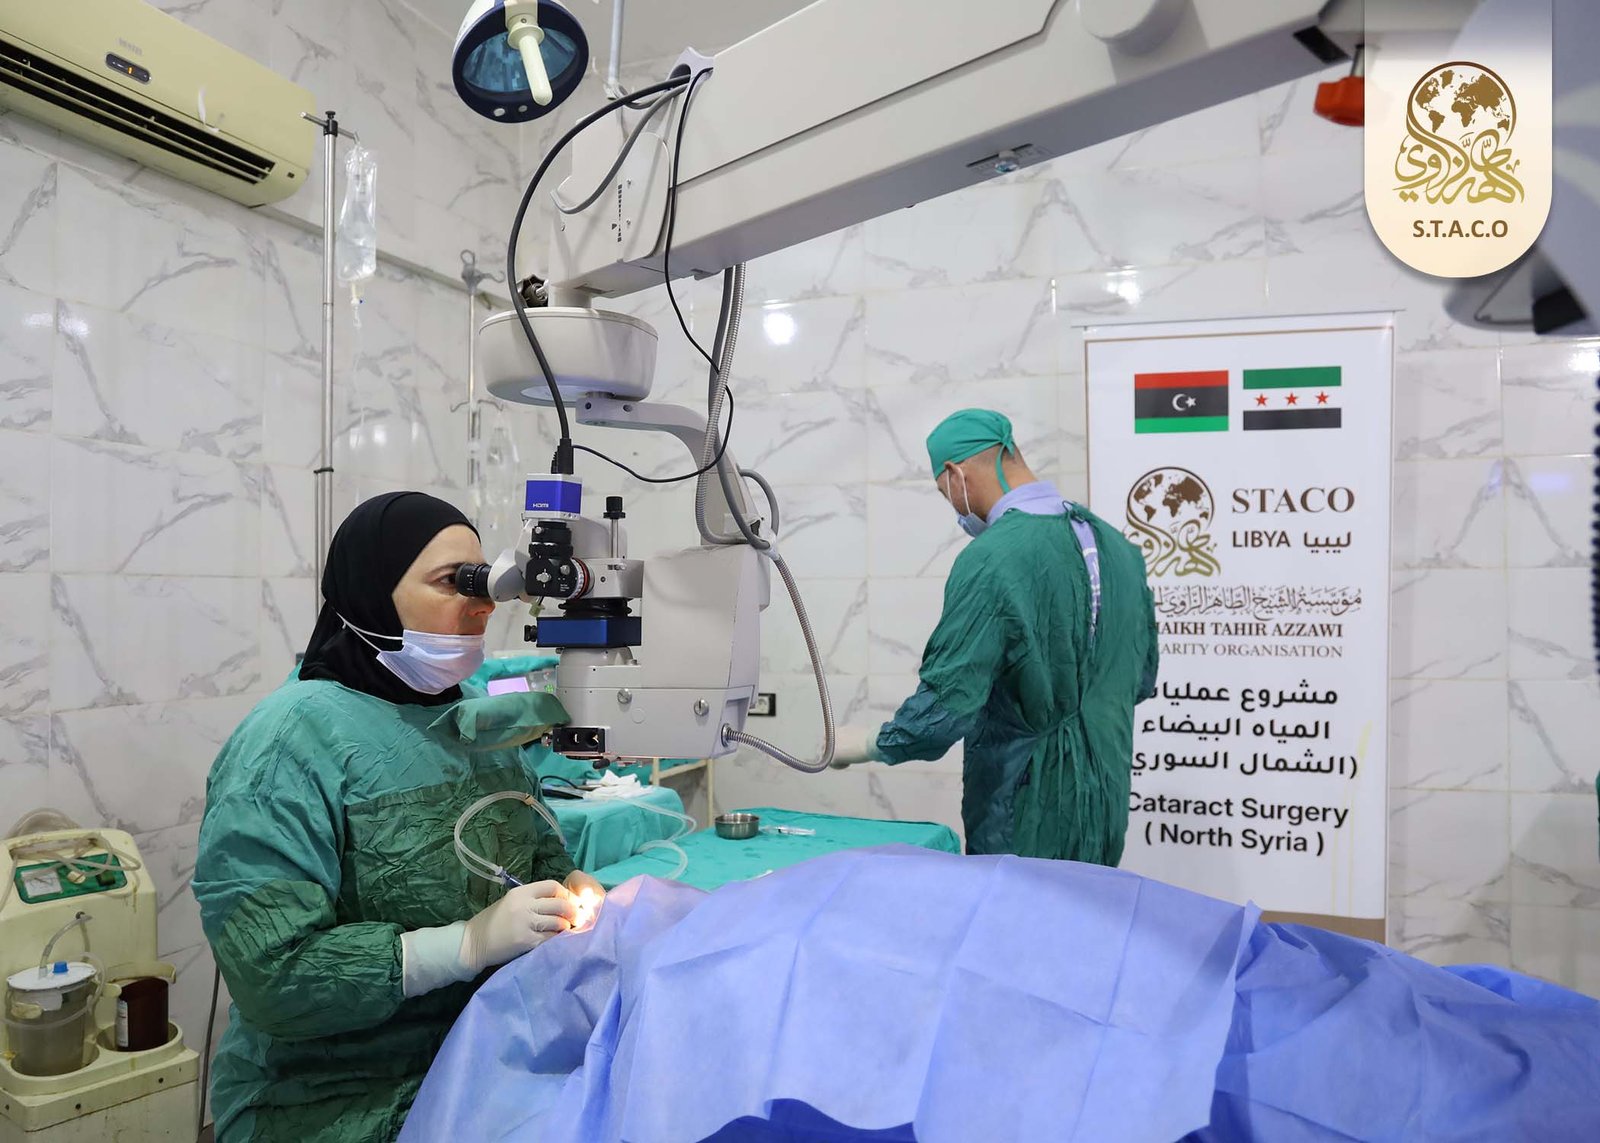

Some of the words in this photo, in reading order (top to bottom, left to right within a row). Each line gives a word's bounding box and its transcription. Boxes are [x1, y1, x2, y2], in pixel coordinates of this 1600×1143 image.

[1231, 486, 1355, 514] STACO
[1232, 530, 1291, 548] LIBYA
[1303, 531, 1352, 554] ليبيا
[1155, 621, 1205, 635] AIKH
[1210, 622, 1268, 636] TAHIR
[1272, 623, 1343, 637] AZZAWI
[1161, 643, 1209, 656] ARITY
[1214, 643, 1343, 658] ORGANISATION
[1240, 679, 1338, 713] مشروع
[1142, 714, 1241, 742] البيضاء
[1252, 719, 1330, 744] المياه
[1241, 797, 1349, 829] Surgery
[1160, 823, 1232, 848] North
[1241, 828, 1308, 855] Syria
